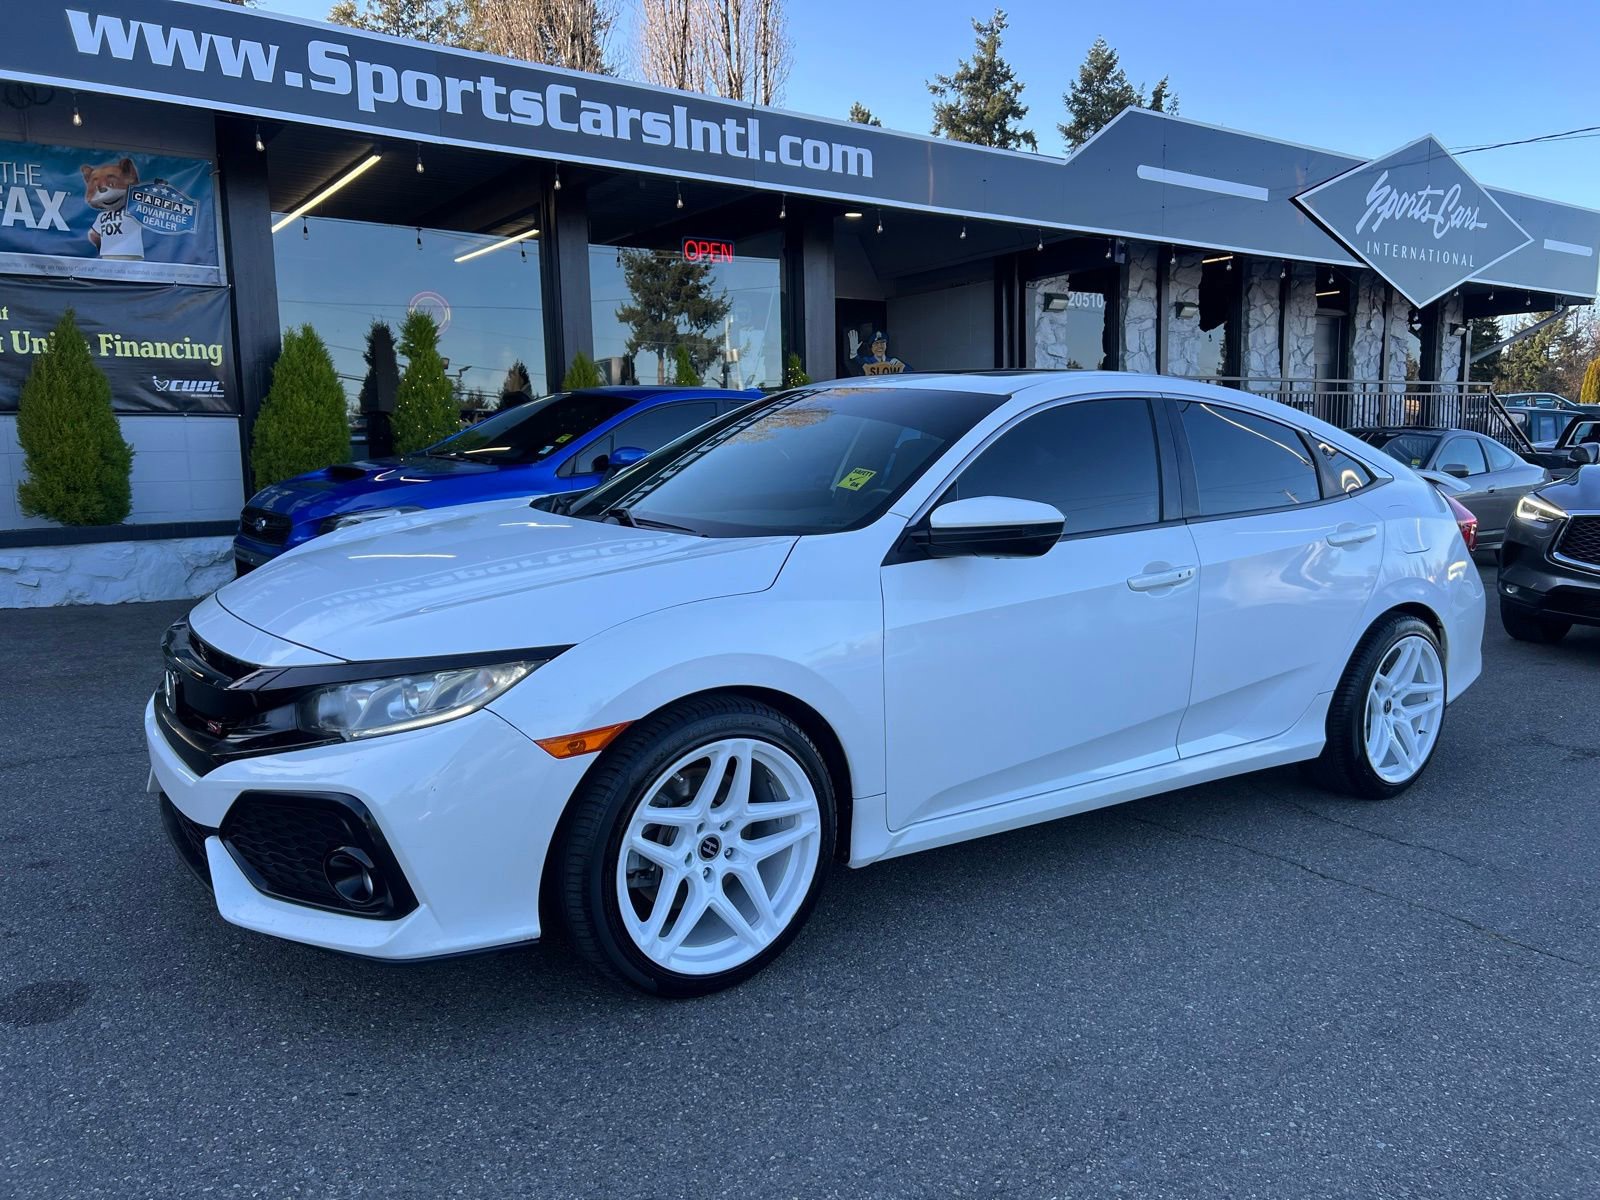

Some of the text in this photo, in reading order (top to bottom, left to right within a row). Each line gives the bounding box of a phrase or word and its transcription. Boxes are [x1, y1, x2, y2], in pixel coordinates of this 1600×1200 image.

[0, 161, 42, 187] THE
[0, 184, 71, 232] AX
[133, 191, 193, 216] CARFAX
[135, 204, 188, 225] ADVANTAGE
[100, 209, 123, 224] CAR
[142, 215, 178, 232] DEALER
[100, 222, 123, 237] FOX
[684, 240, 733, 264] OPEN
[1366, 241, 1475, 268] INTERNATIONAL
[1068, 292, 1105, 308] 20510
[97, 333, 223, 366] Financing
